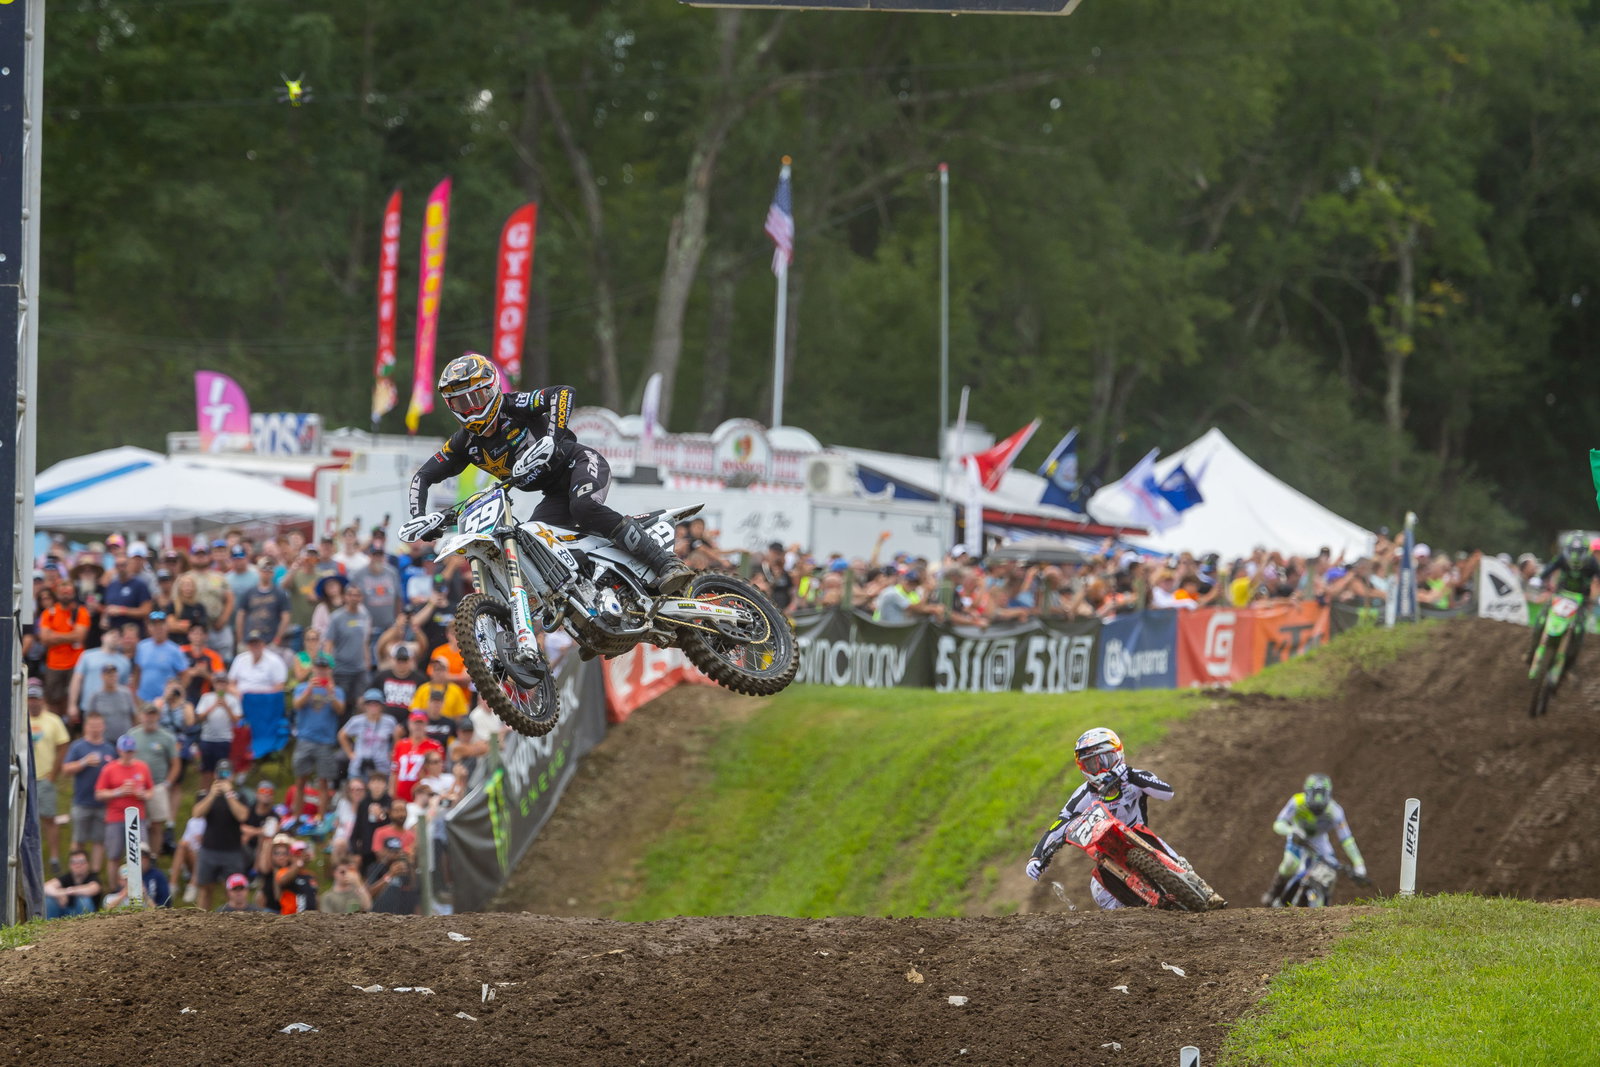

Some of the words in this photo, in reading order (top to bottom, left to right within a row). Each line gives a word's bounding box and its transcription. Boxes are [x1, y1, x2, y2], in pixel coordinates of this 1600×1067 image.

[500, 222, 531, 358] GYROS
[557, 389, 569, 429] ROCKSTAR
[465, 498, 501, 535] 59
[398, 753, 425, 782] 17
[1138, 773, 1171, 788] HONDA
[129, 831, 137, 864] UFO
[1406, 822, 1415, 856] UFO
